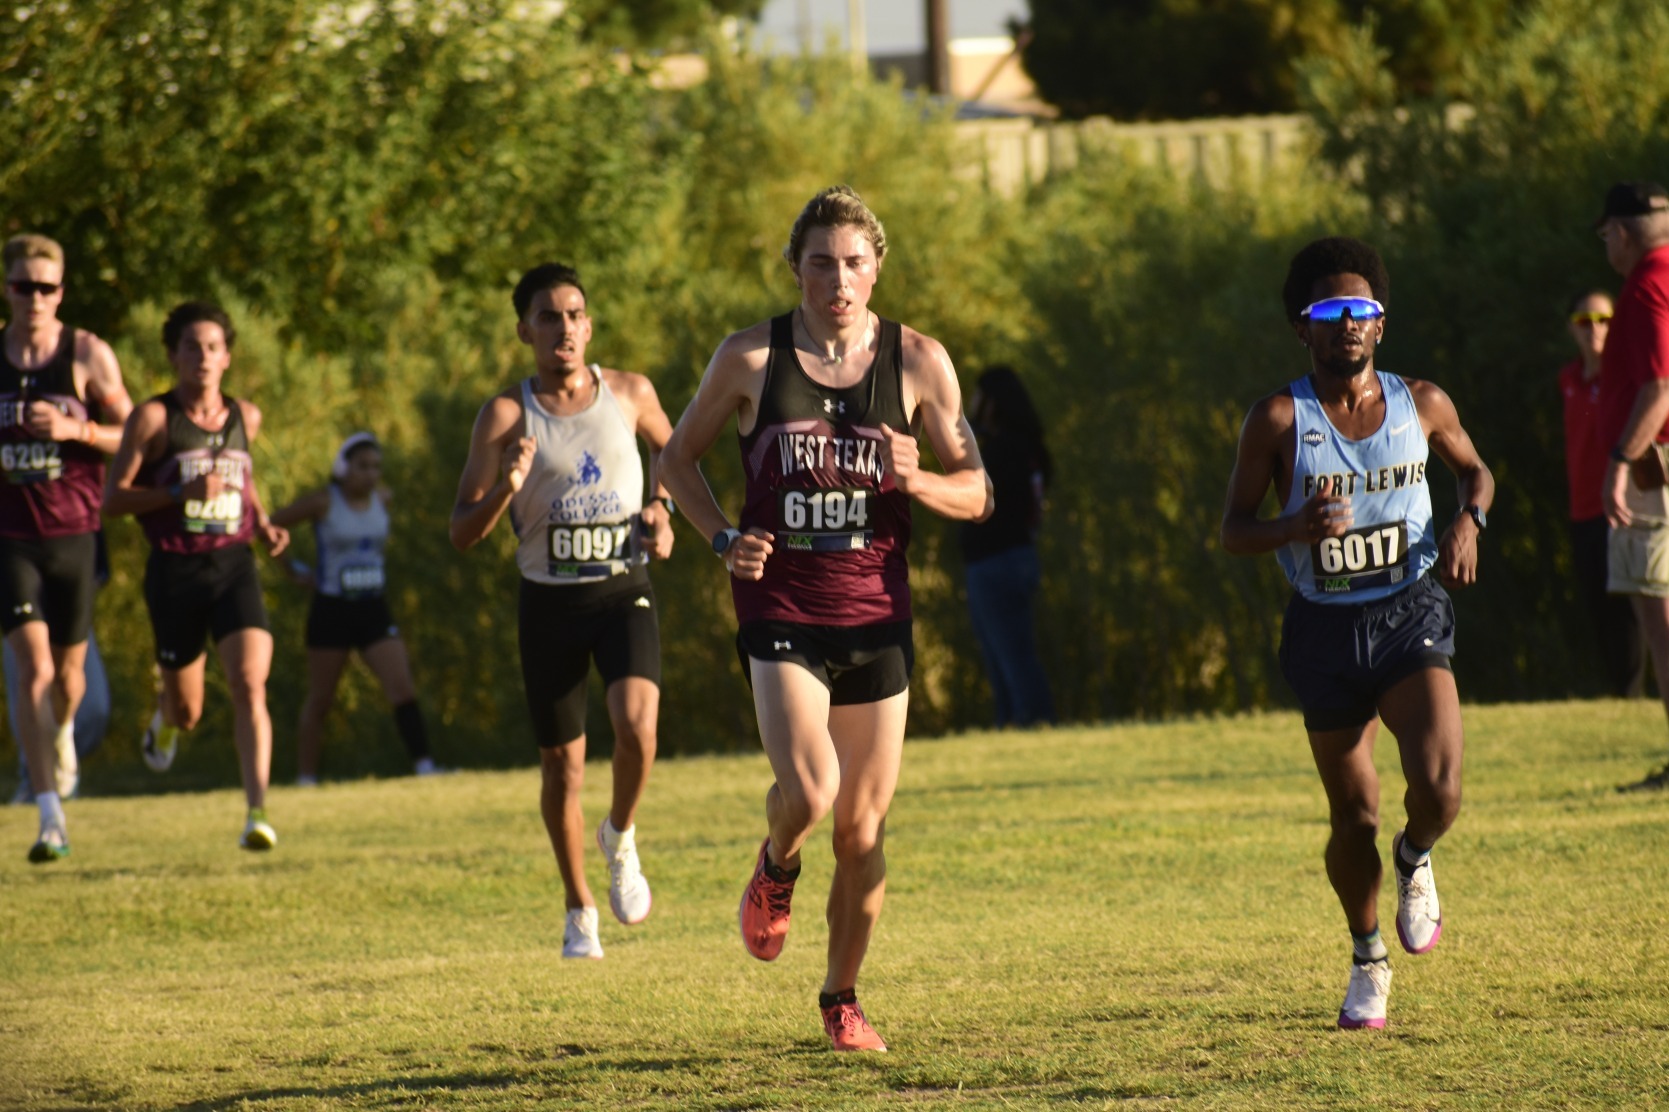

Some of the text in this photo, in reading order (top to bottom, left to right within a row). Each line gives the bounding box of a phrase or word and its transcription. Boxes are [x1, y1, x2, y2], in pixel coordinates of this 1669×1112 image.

[1, 443, 62, 471] 6202
[777, 433, 827, 477] WEST
[1304, 461, 1425, 498] FORT LEWIS
[552, 490, 620, 511] ODESSA
[784, 490, 868, 530] 6194
[552, 526, 626, 561] 6097
[1320, 526, 1400, 574] 6017
